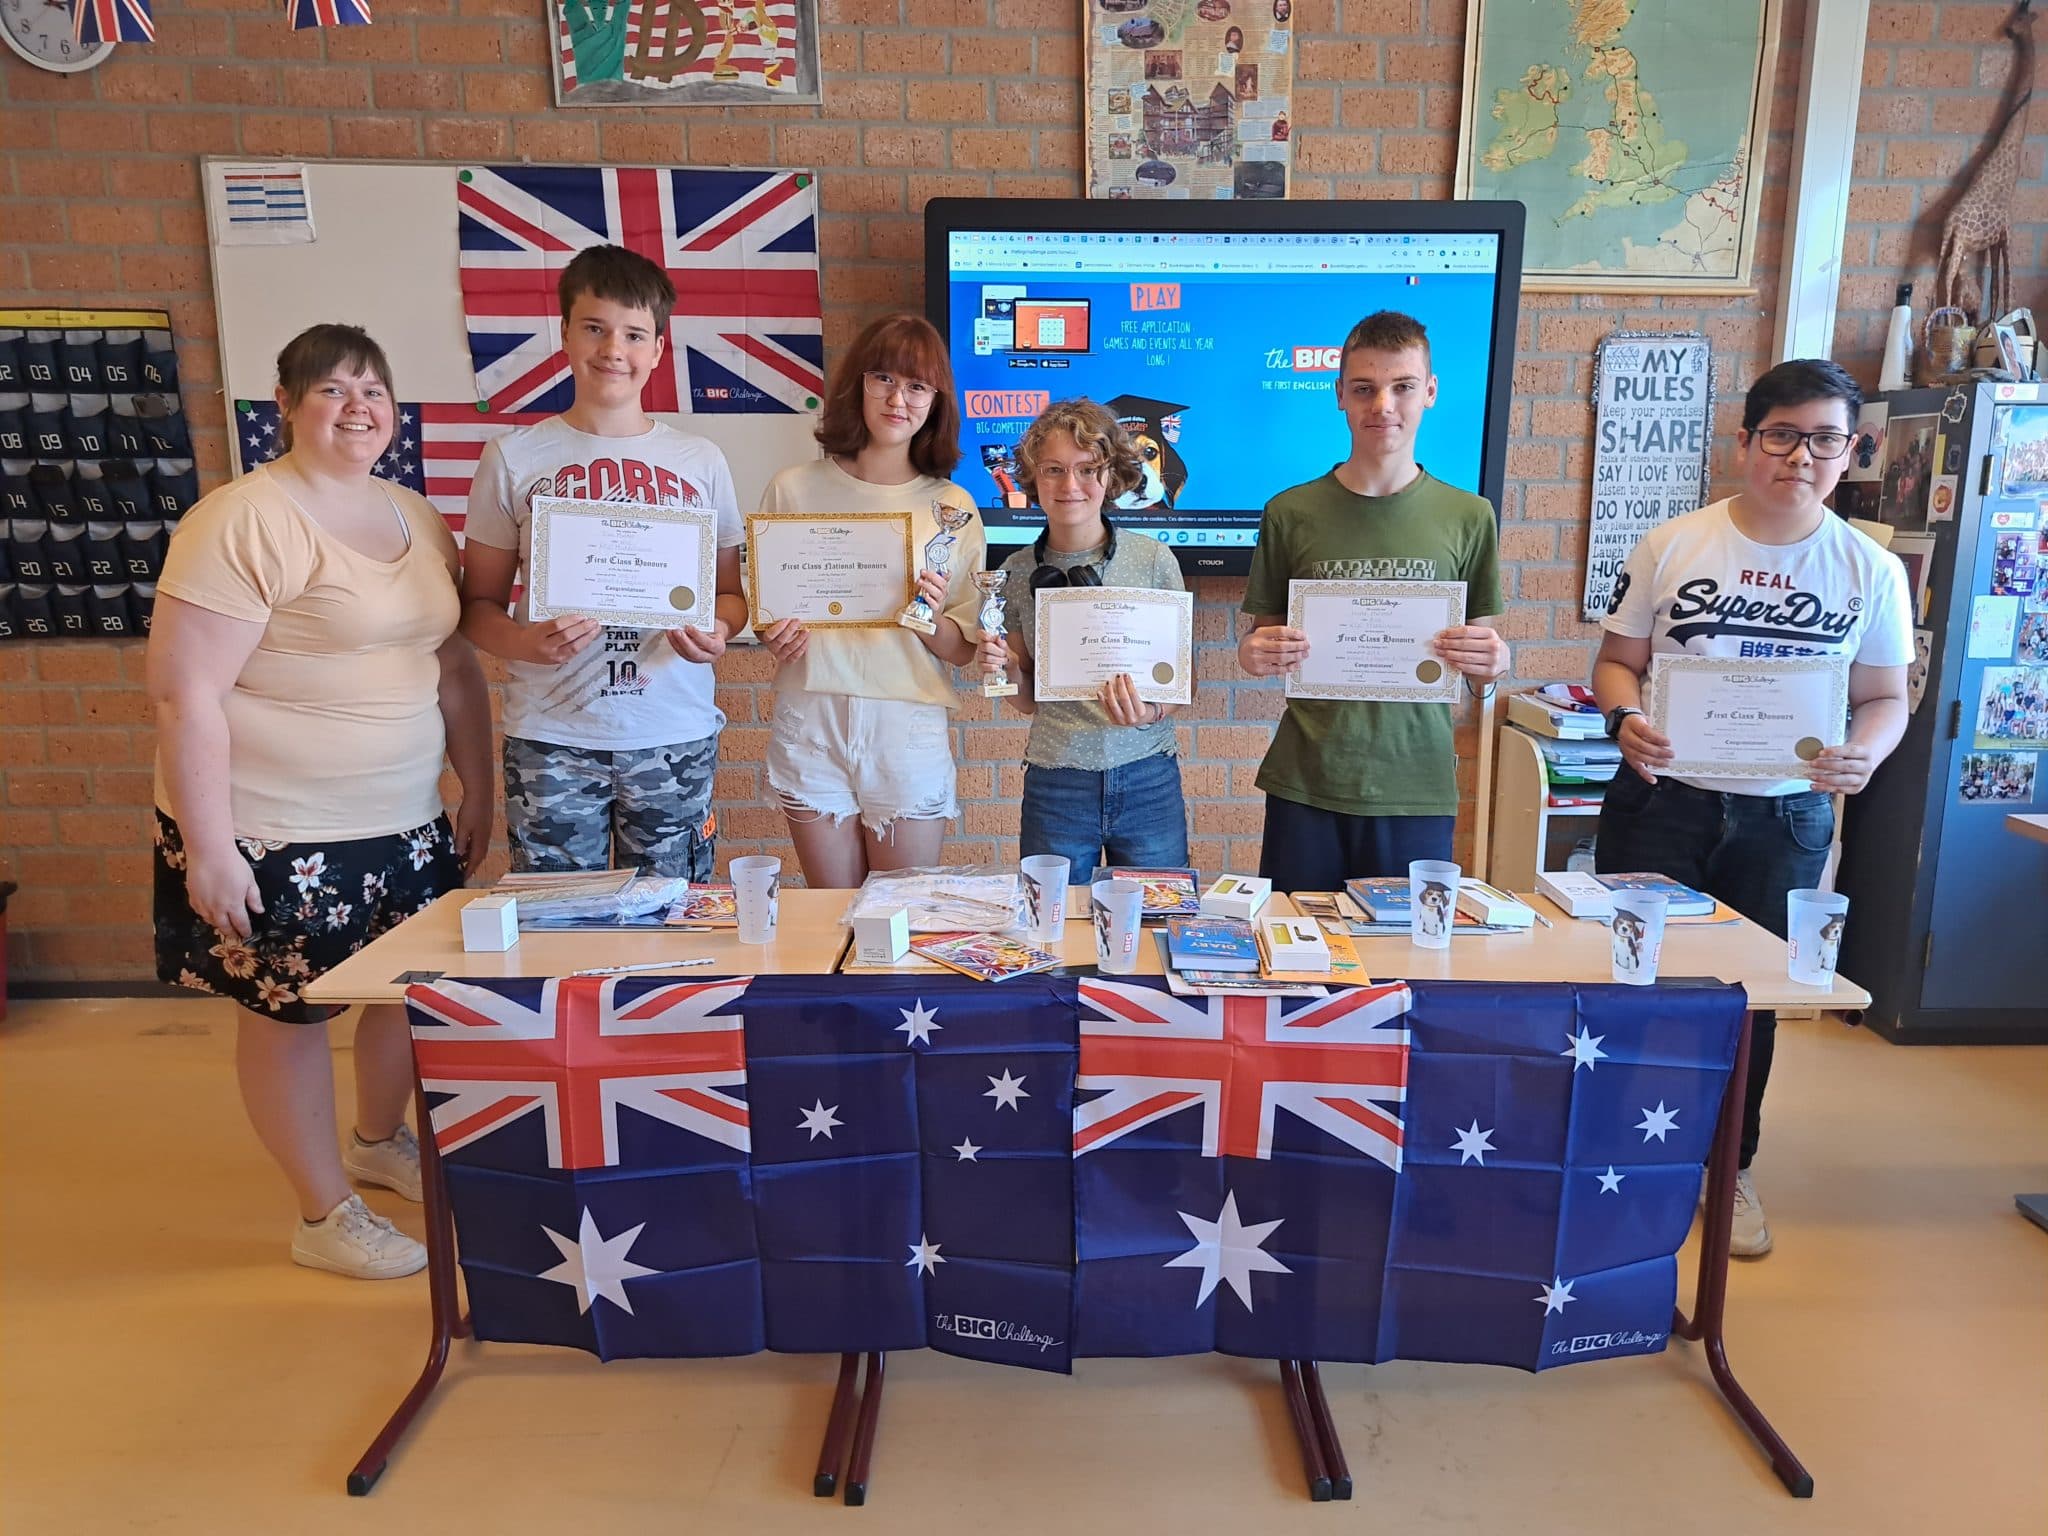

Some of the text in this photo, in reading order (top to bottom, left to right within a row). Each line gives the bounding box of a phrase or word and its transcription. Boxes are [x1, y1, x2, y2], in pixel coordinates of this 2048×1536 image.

[21, 19, 30, 33] 8
[40, 34, 48, 49] 7
[60, 40, 70, 54] 6
[1135, 286, 1177, 308] PLAY
[1121, 321, 1191, 334] FREE APPLICATION
[1104, 338, 1214, 350] GAMES AND EVENTS ALL YEAR
[1146, 354, 1165, 366] LONG
[1264, 348, 1341, 368] the BIG
[1642, 349, 1687, 374] MY
[30, 365, 51, 381] 03
[69, 366, 92, 382] 04
[106, 366, 128, 382] 05
[1293, 382, 1331, 390] ENGLISH
[1614, 376, 1694, 402] RULES
[706, 388, 728, 398] BIG
[730, 388, 766, 402] Challenge
[970, 393, 1042, 415] CONTEST
[1602, 405, 1704, 420] Keep your promises
[976, 422, 990, 434] BIG
[1, 432, 22, 448] 08
[40, 434, 63, 450] 09
[78, 436, 100, 451] 10
[120, 434, 138, 450] 11
[1600, 420, 1702, 453] SHARE
[1598, 465, 1700, 482] SAY I LOVE YOU
[1598, 484, 1698, 499] Listen to your parents
[8, 494, 28, 508] 14
[82, 497, 104, 512] 16
[118, 501, 136, 514] 17
[158, 496, 177, 511] 18
[48, 504, 69, 517] 15
[1596, 500, 1618, 520] DO
[1625, 500, 1660, 520] YOUR
[1594, 521, 1608, 532] Say
[1611, 522, 1634, 532] please
[1594, 534, 1627, 544] ALWAYS
[1592, 546, 1624, 560] Laugh
[91, 560, 113, 575] 22
[128, 559, 148, 574] 23
[584, 554, 668, 568] First Class Honours
[780, 563, 799, 571] First
[824, 562, 854, 570] National
[857, 562, 887, 570] Honours
[20, 562, 41, 576] 20
[53, 562, 73, 576] 21
[1590, 580, 1610, 593] Use
[1740, 570, 1796, 590] REAL
[1670, 578, 1858, 638] SuperDry
[0, 621, 12, 636] 5
[26, 618, 48, 633] 26
[64, 615, 84, 629] 27
[102, 616, 124, 631] 28
[142, 615, 152, 629] 2
[606, 632, 638, 640] FAIR
[1080, 636, 1151, 646] First Class Honours
[1336, 634, 1415, 643] First Class Honours
[604, 642, 640, 652] PLAY
[606, 660, 637, 687] 10
[1704, 710, 1794, 721] First Class Honours
[1124, 932, 1132, 952] BIG
[935, 1313, 1064, 1352] the BIG Challenge
[1552, 1331, 1667, 1354] the BIG Challenge
